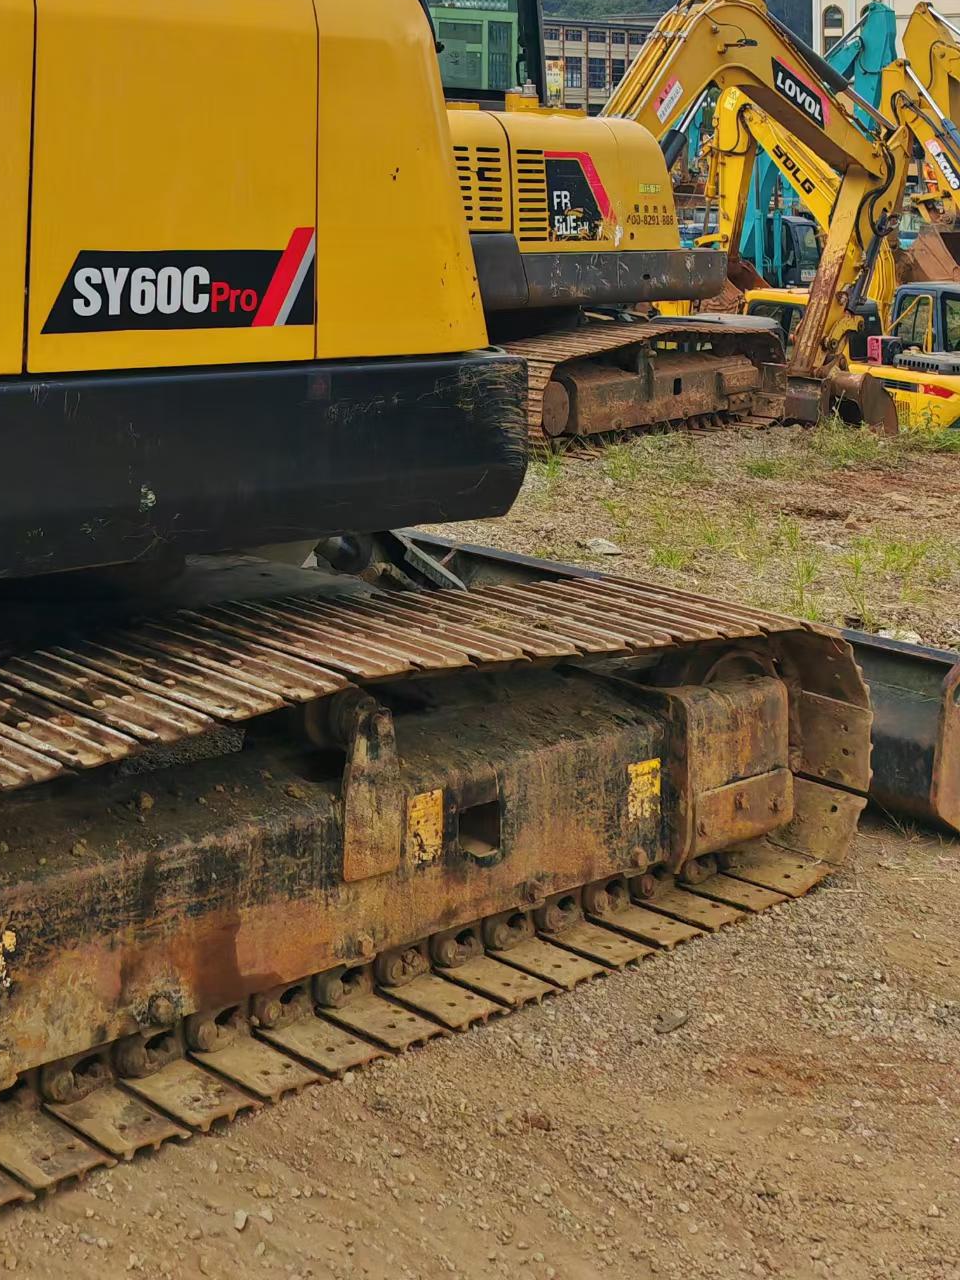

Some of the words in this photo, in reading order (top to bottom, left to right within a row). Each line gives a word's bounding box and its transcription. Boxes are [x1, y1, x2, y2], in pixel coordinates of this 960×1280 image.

[776, 71, 823, 122] LOVOL
[772, 144, 816, 195] SDLG
[935, 152, 960, 189] XCMG
[553, 190, 571, 210] FR
[73, 265, 210, 317] SY60C
[210, 282, 257, 313] Pro
